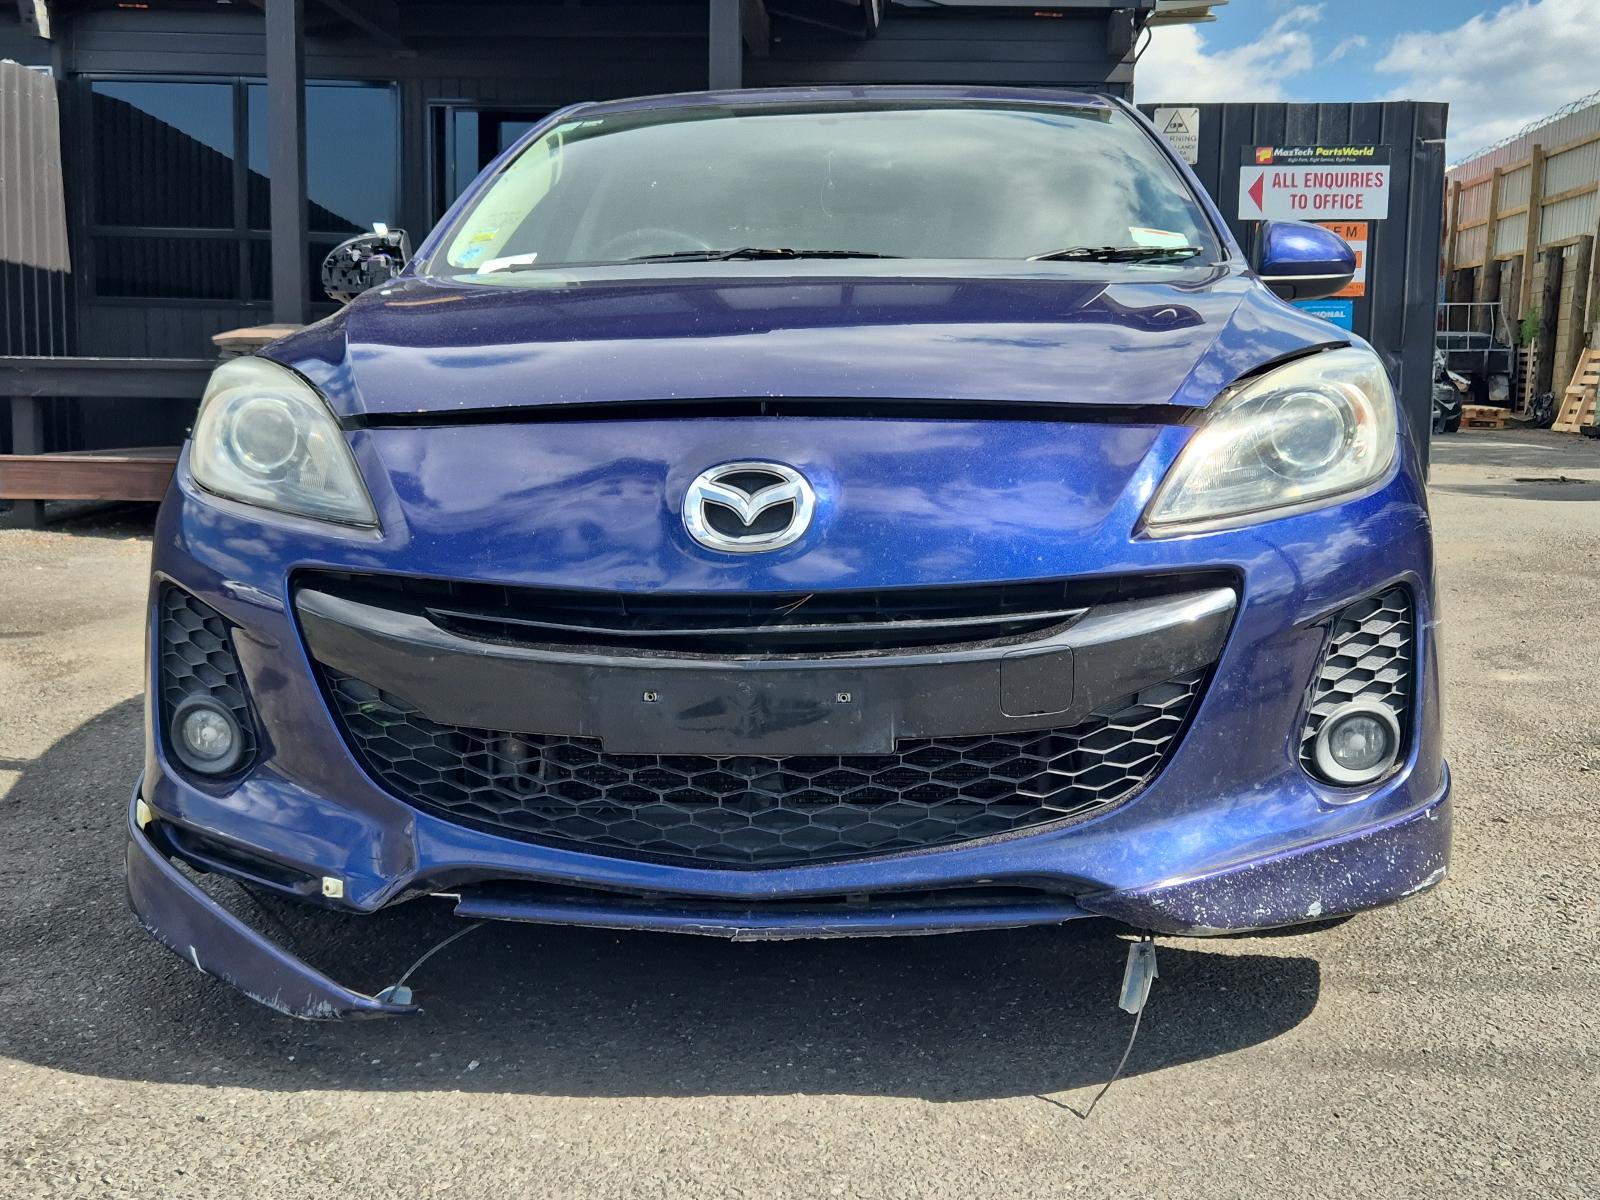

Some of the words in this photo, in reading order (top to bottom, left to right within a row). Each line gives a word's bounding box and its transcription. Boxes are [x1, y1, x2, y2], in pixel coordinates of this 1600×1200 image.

[1273, 147, 1314, 156] MazTech
[1316, 146, 1375, 156] PartsWorld
[1272, 172, 1298, 188] ALL
[1304, 172, 1384, 190] ENQUIRIES
[1290, 193, 1308, 209] TO
[1313, 193, 1364, 209] OFFICE
